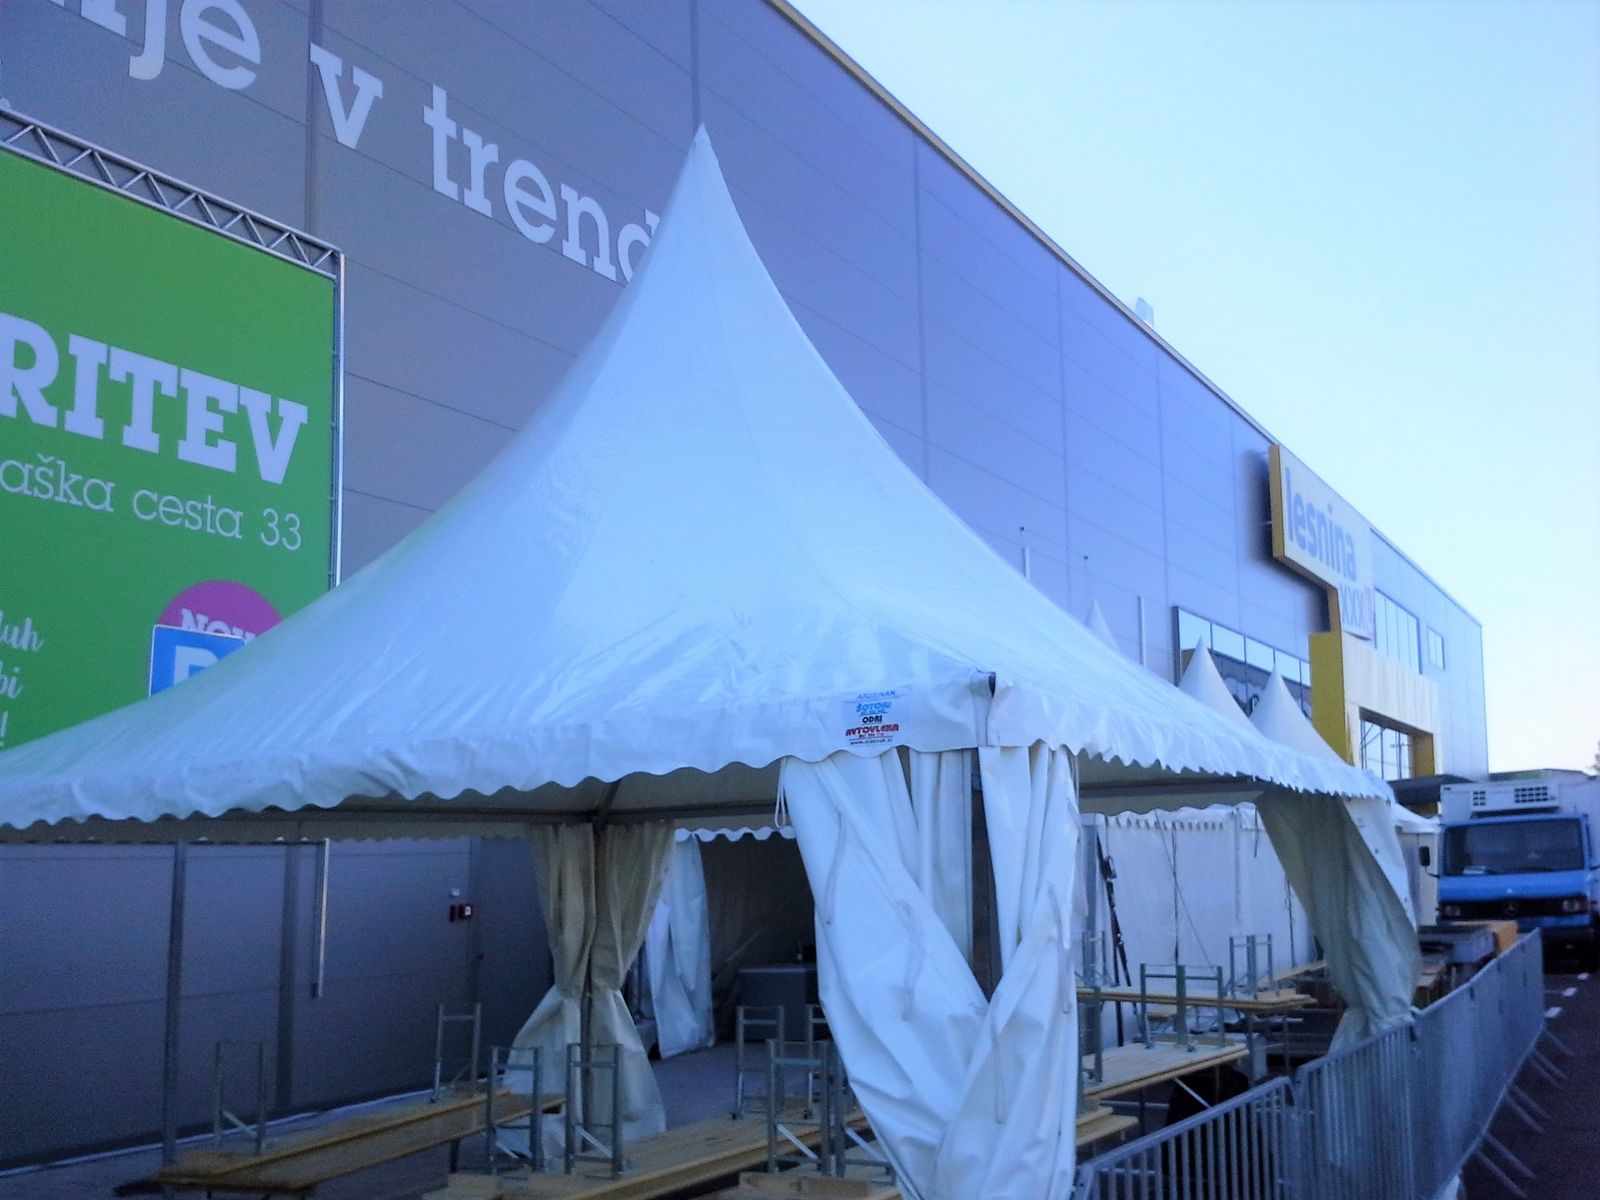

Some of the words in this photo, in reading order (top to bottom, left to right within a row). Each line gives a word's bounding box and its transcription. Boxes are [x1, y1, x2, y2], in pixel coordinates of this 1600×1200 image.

[309, 42, 383, 150] v
[0, 312, 308, 485] RITEV
[0, 452, 115, 513] aška
[132, 489, 243, 539] cesta
[260, 508, 302, 550] 33
[1284, 466, 1357, 581] lesnina
[862, 715, 883, 724] ODRI
